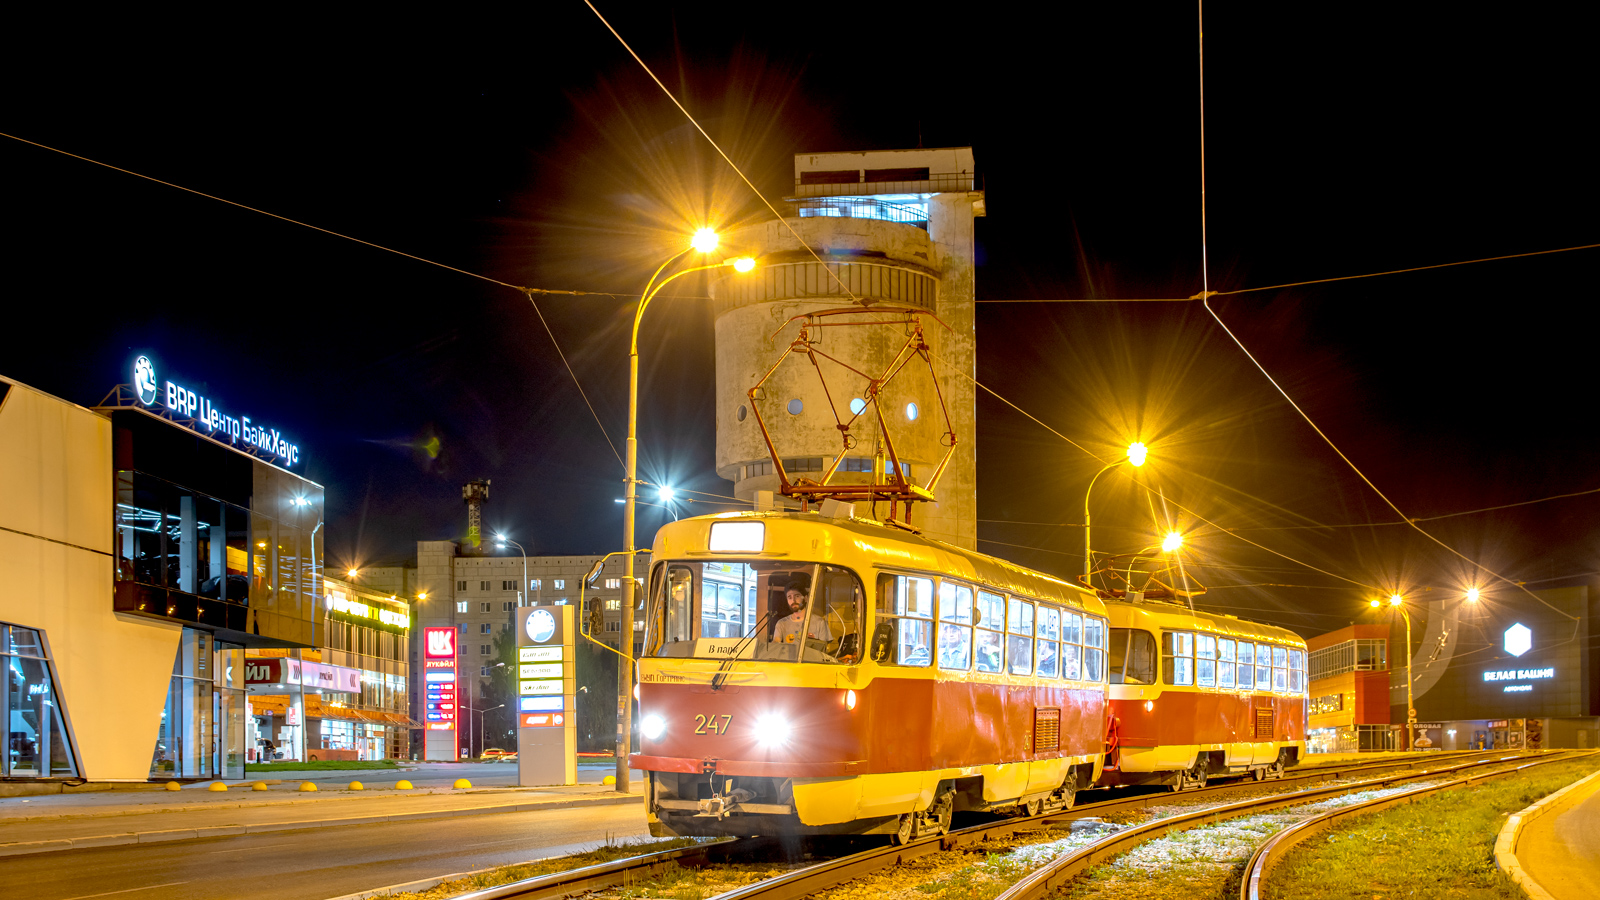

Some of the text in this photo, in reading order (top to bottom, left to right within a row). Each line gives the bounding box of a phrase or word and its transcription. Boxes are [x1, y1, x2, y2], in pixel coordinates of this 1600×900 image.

[165, 380, 299, 467] BRP Центр БайкХаус
[708, 644, 715, 654] В
[1484, 668, 1554, 681] БЕЛАЯ БАШНЯ
[694, 714, 733, 735] 247
